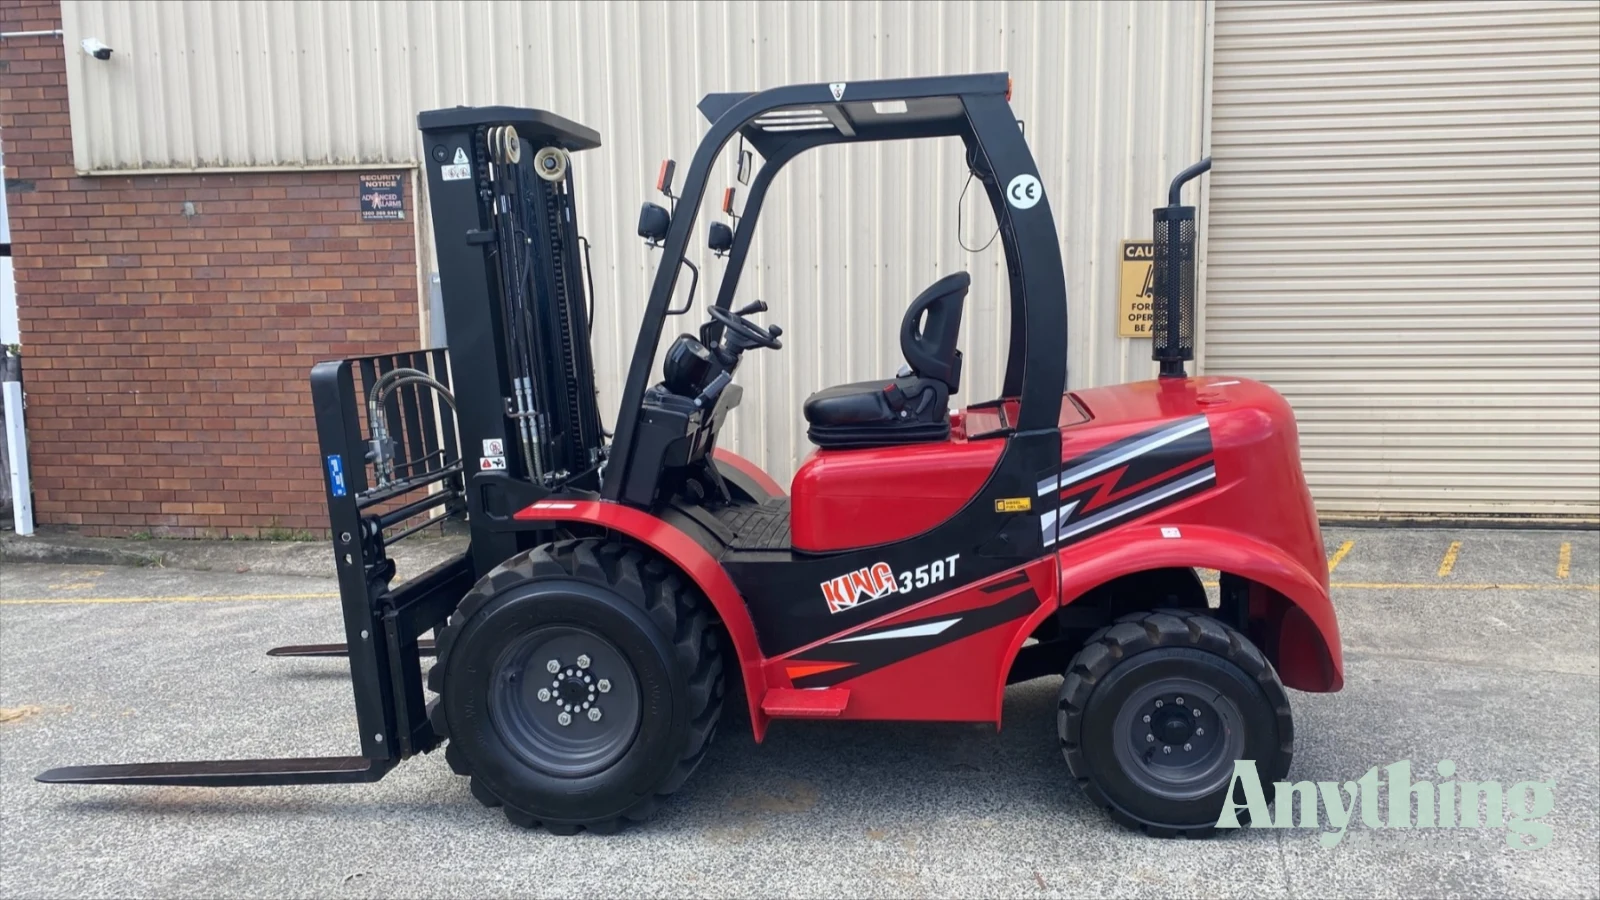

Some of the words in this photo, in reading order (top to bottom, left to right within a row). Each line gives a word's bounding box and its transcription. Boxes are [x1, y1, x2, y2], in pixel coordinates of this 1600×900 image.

[1011, 182, 1035, 200] CE
[1126, 246, 1154, 257] CAU
[1128, 313, 1154, 322] OPER
[1134, 324, 1145, 332] BE
[820, 561, 898, 614] KING
[898, 553, 960, 594] 35AT
